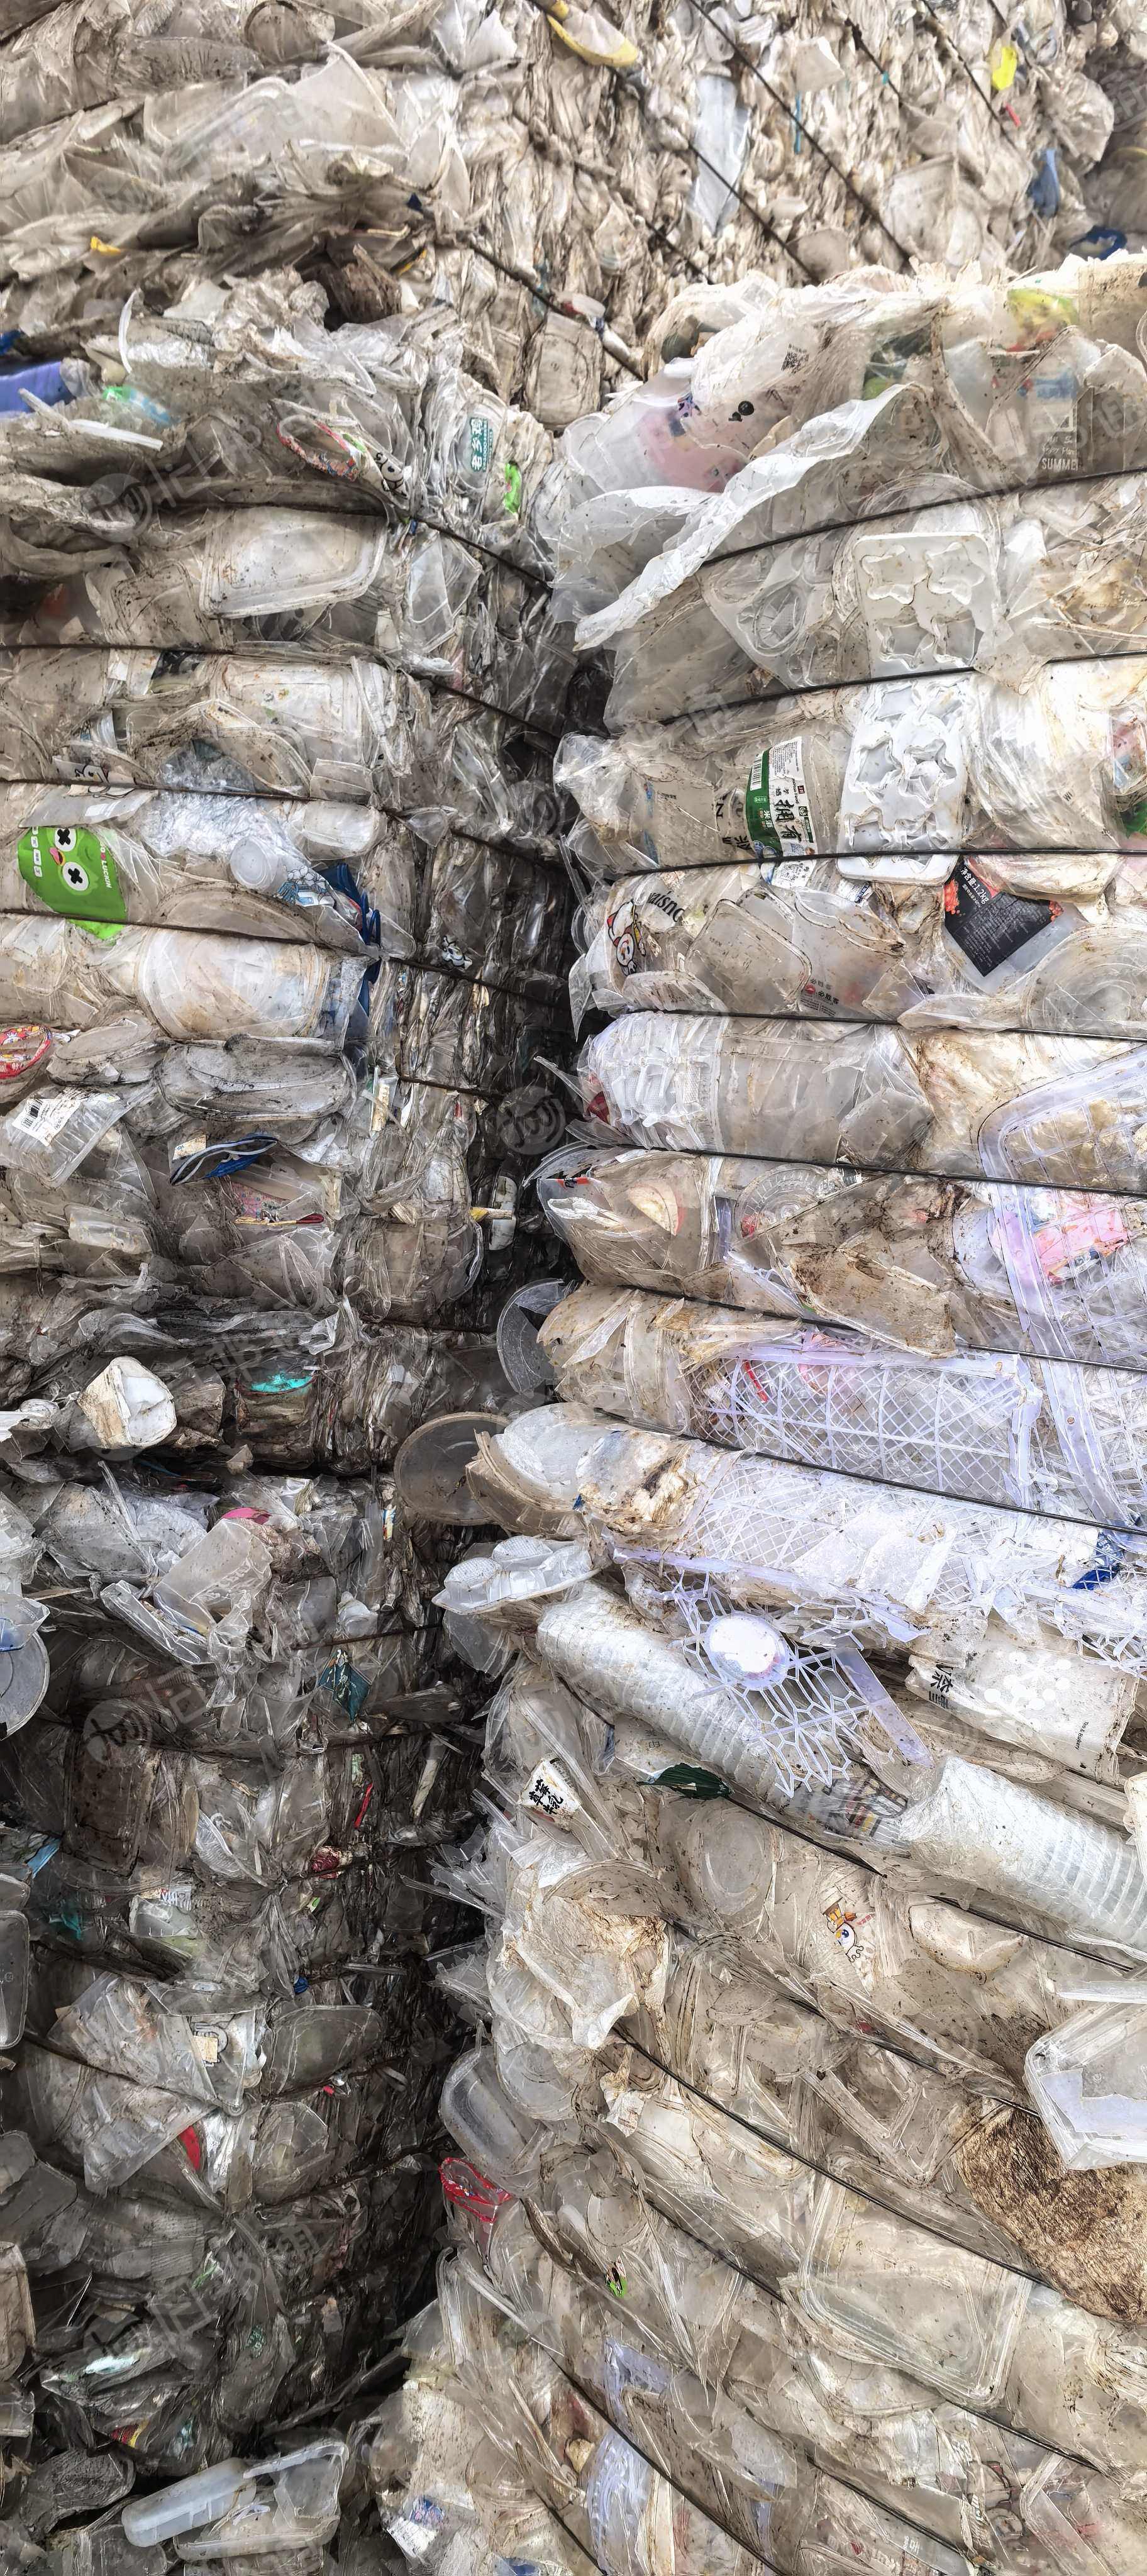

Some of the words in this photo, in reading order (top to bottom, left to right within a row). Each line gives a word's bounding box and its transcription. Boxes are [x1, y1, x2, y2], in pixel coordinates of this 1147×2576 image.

[101, 860, 113, 889] LUCKIN
[529, 1779, 551, 1806] 草莓
[543, 1794, 564, 1815] 牛乳
